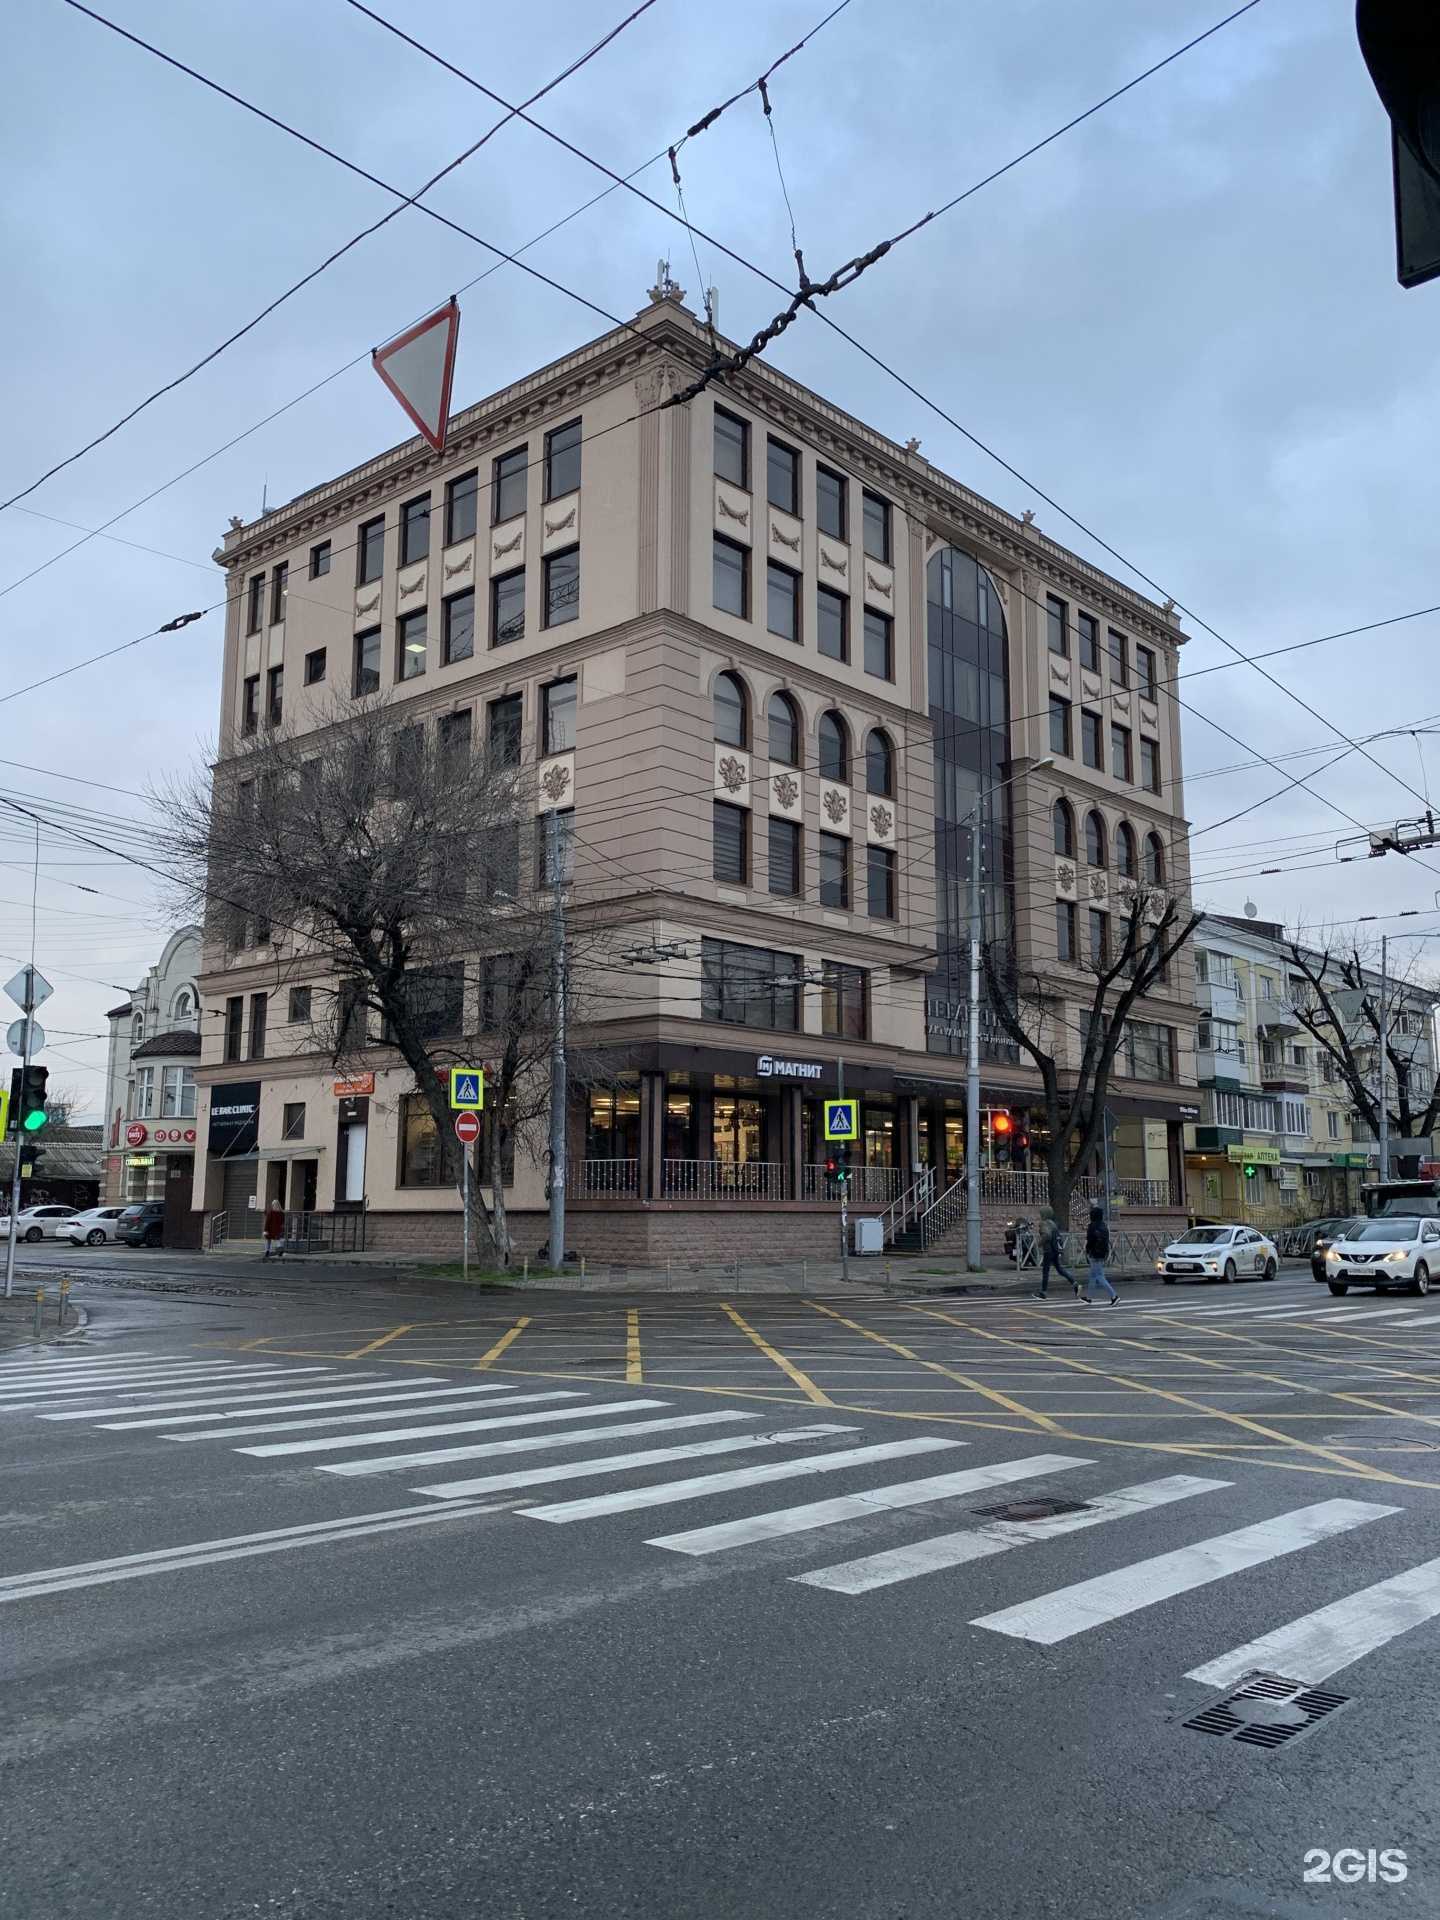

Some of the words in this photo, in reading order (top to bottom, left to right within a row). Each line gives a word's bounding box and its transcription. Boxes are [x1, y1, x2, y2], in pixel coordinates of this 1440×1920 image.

[774, 1061, 823, 1079] МАГНИТ
[232, 1104, 255, 1114] CLINIC
[1257, 1151, 1278, 1162] АПТЕКА
